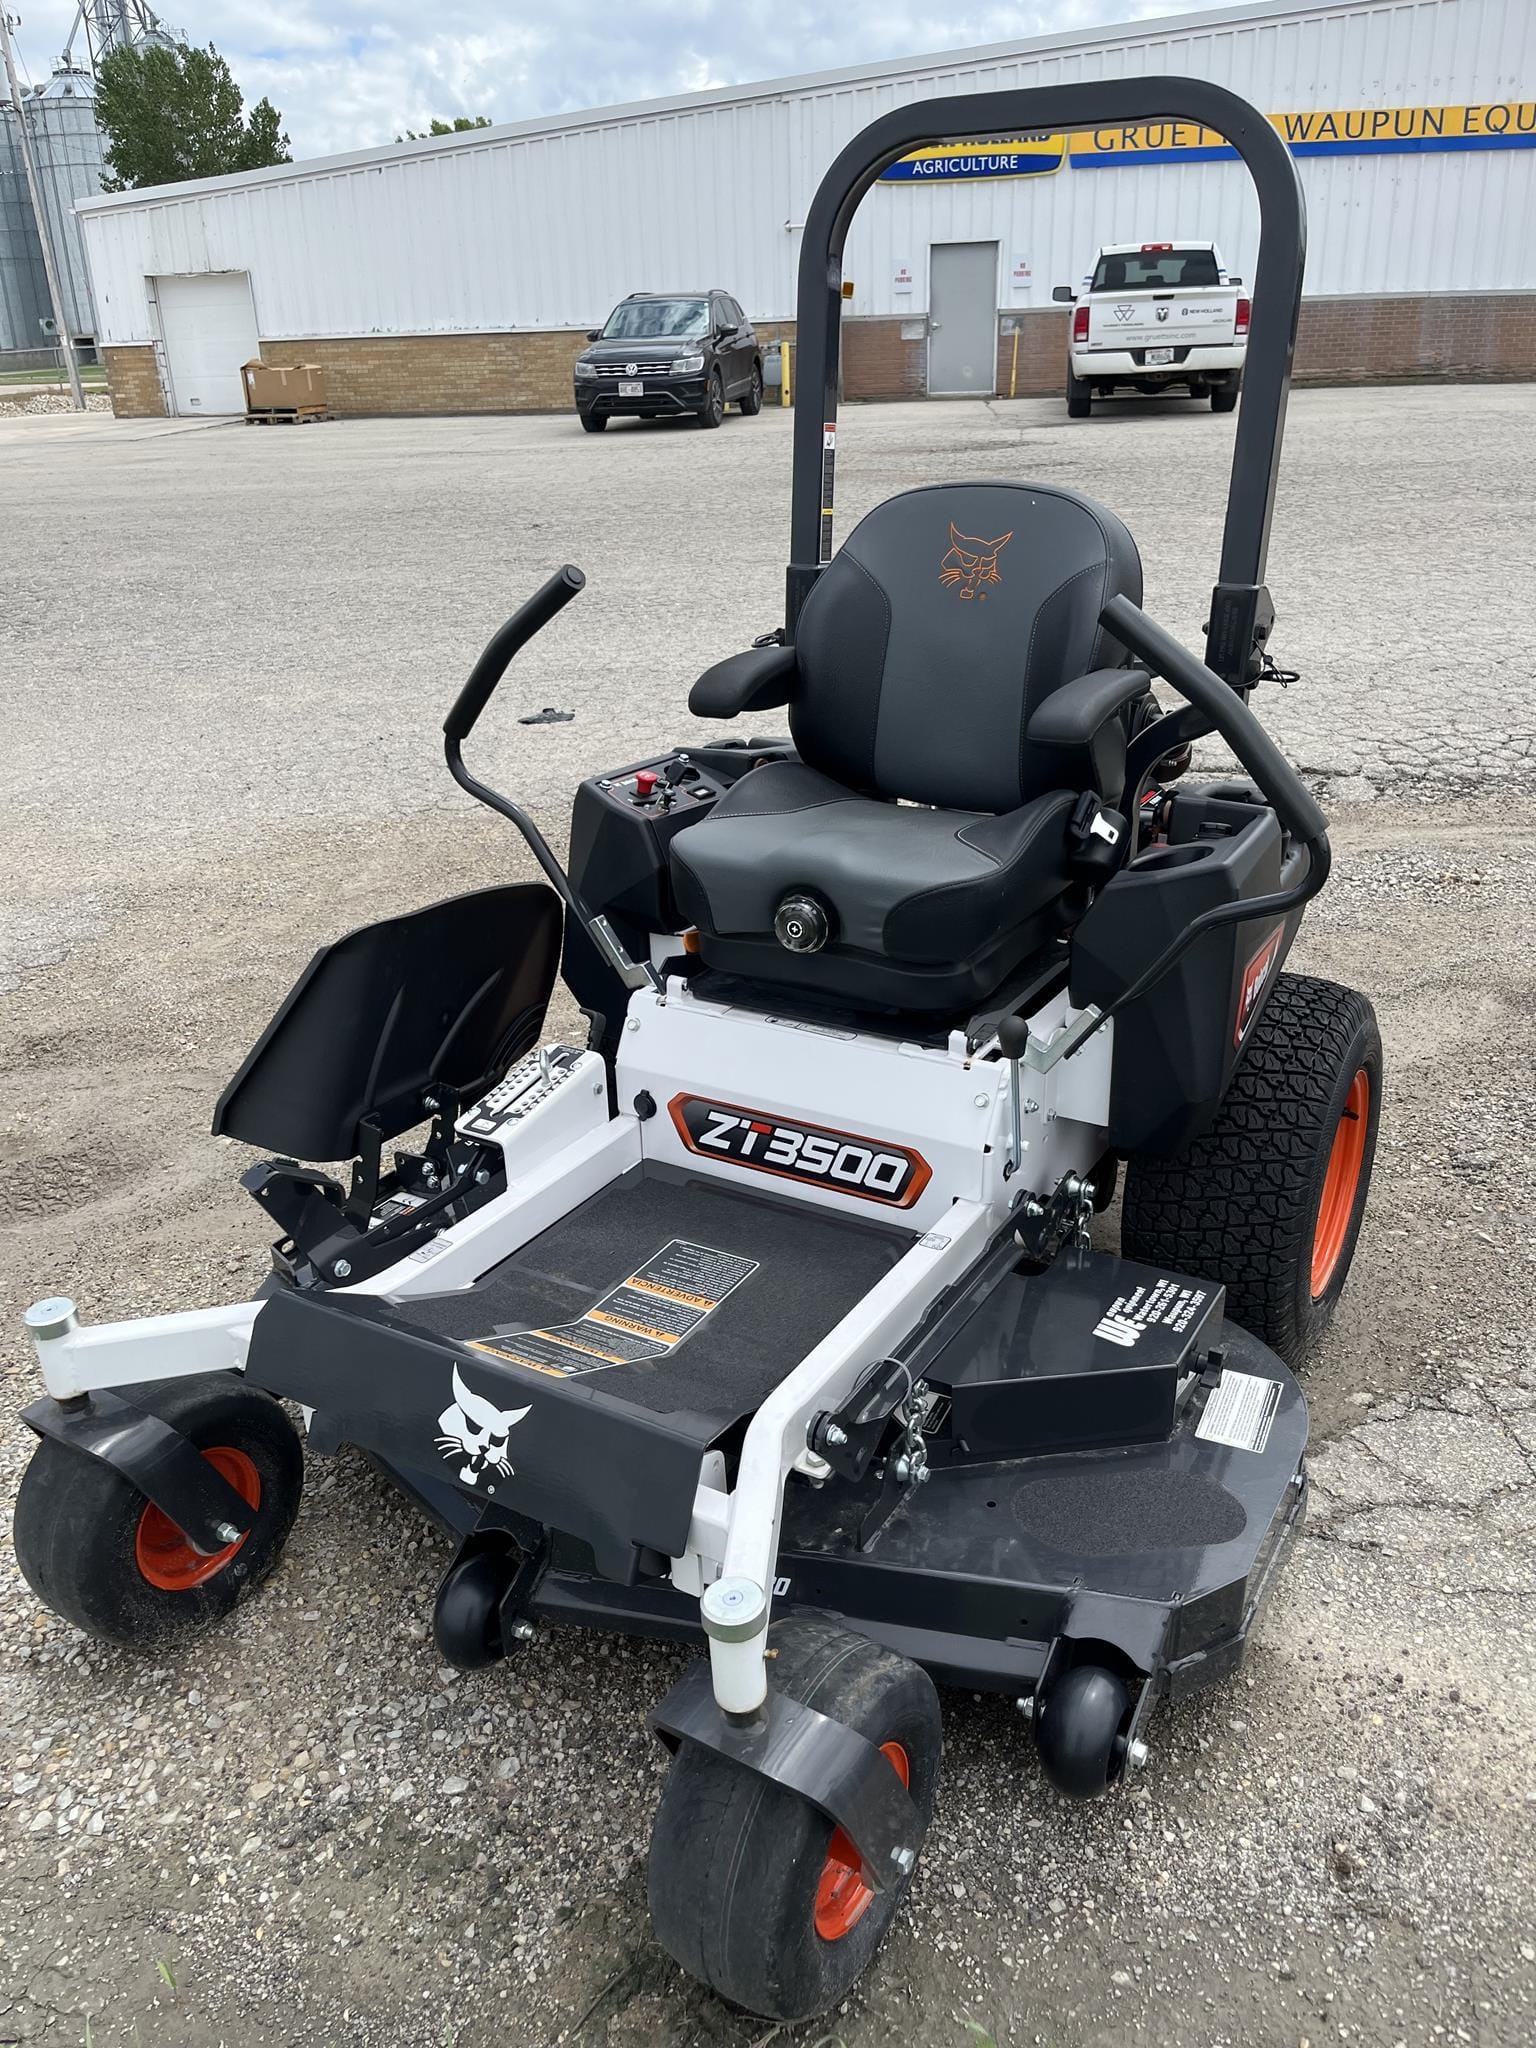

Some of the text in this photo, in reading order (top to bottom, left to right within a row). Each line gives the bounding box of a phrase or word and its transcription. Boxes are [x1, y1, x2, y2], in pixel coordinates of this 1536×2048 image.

[1284, 108, 1445, 141] WAUPUN
[1463, 104, 1536, 134] EQU
[912, 155, 1019, 175] AGRICULTURE
[699, 1111, 909, 1193] ZT3500
[632, 1278, 702, 1303] ADVERTENCIA
[1132, 1288, 1166, 1321] Watertown,
[1162, 1299, 1189, 1324] Waupun,
[604, 1315, 652, 1335] WARNING
